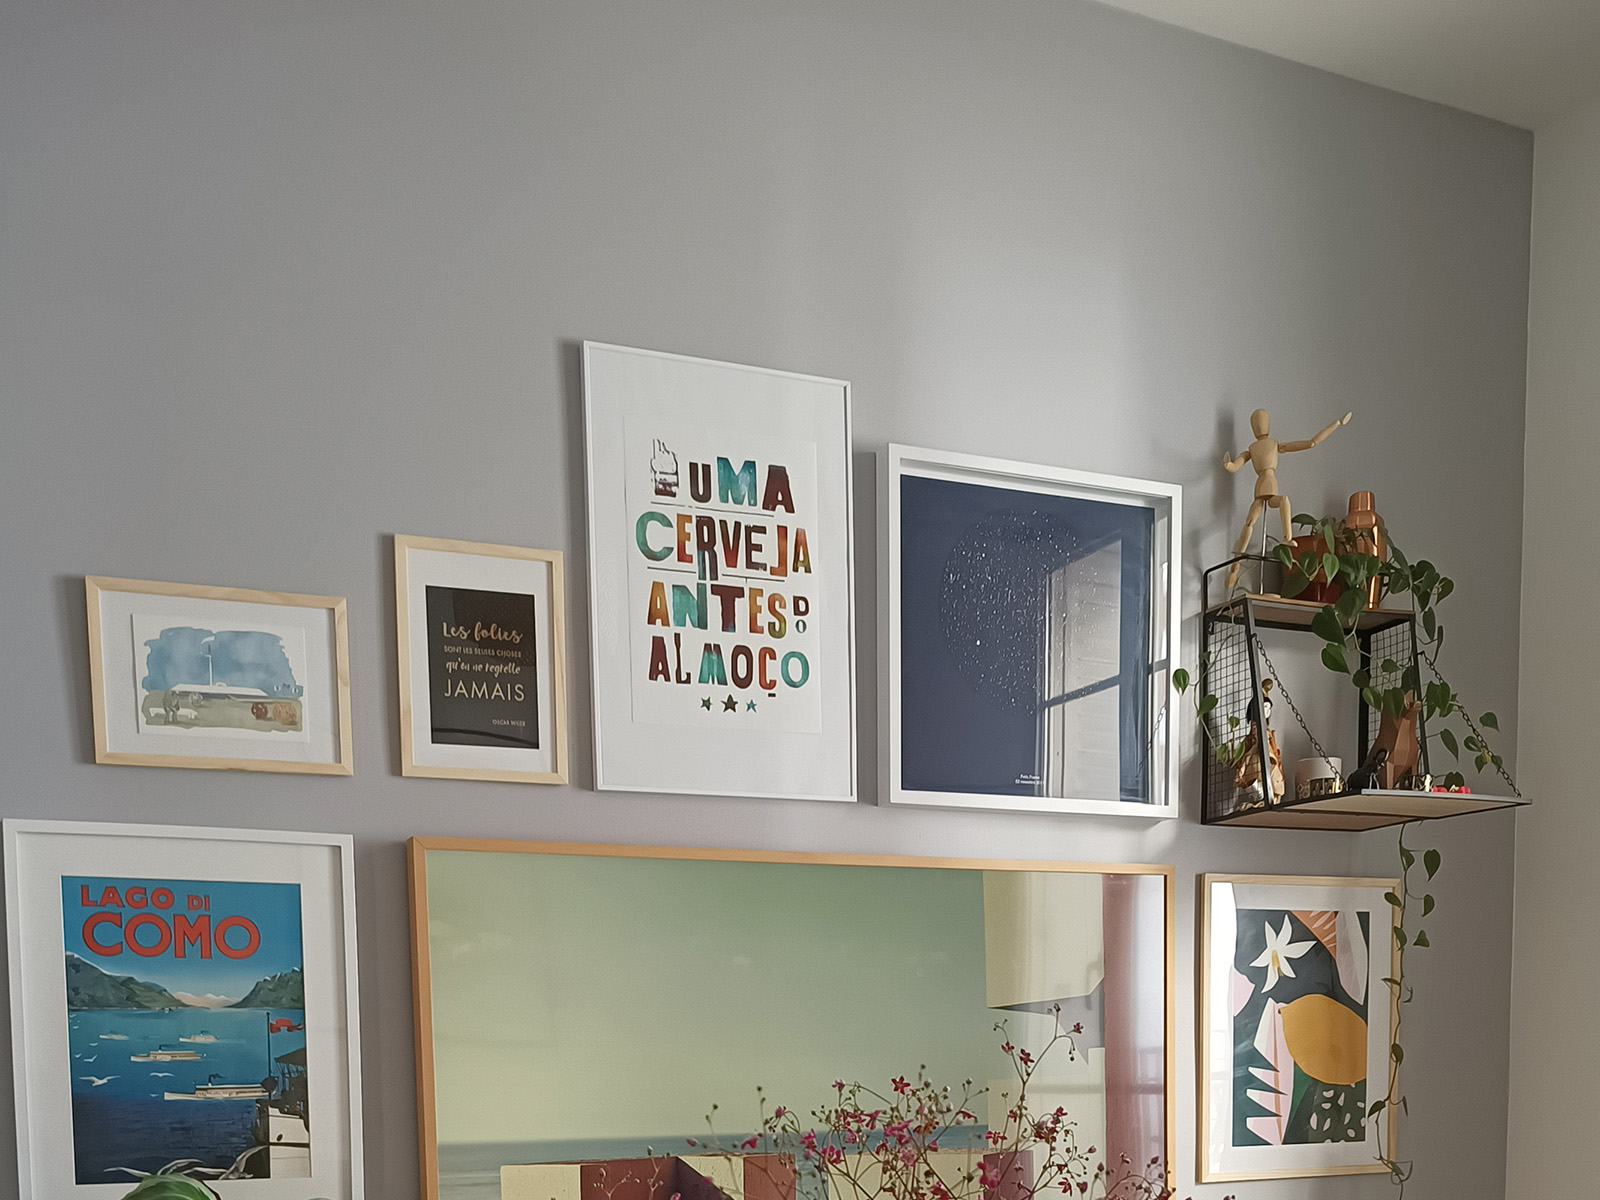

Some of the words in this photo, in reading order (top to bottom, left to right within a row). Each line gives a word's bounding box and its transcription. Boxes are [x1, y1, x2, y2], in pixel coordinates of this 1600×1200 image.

[689, 457, 795, 513] UMA
[635, 511, 812, 581] CERVEJA
[442, 621, 471, 640] Les
[474, 621, 524, 644] folies
[647, 581, 787, 639] ANTES
[444, 679, 525, 702] JAMAIS
[648, 633, 810, 697] ALMOÇO
[80, 884, 175, 910] LAGO
[187, 894, 211, 911] DI
[82, 911, 261, 960] COMO
